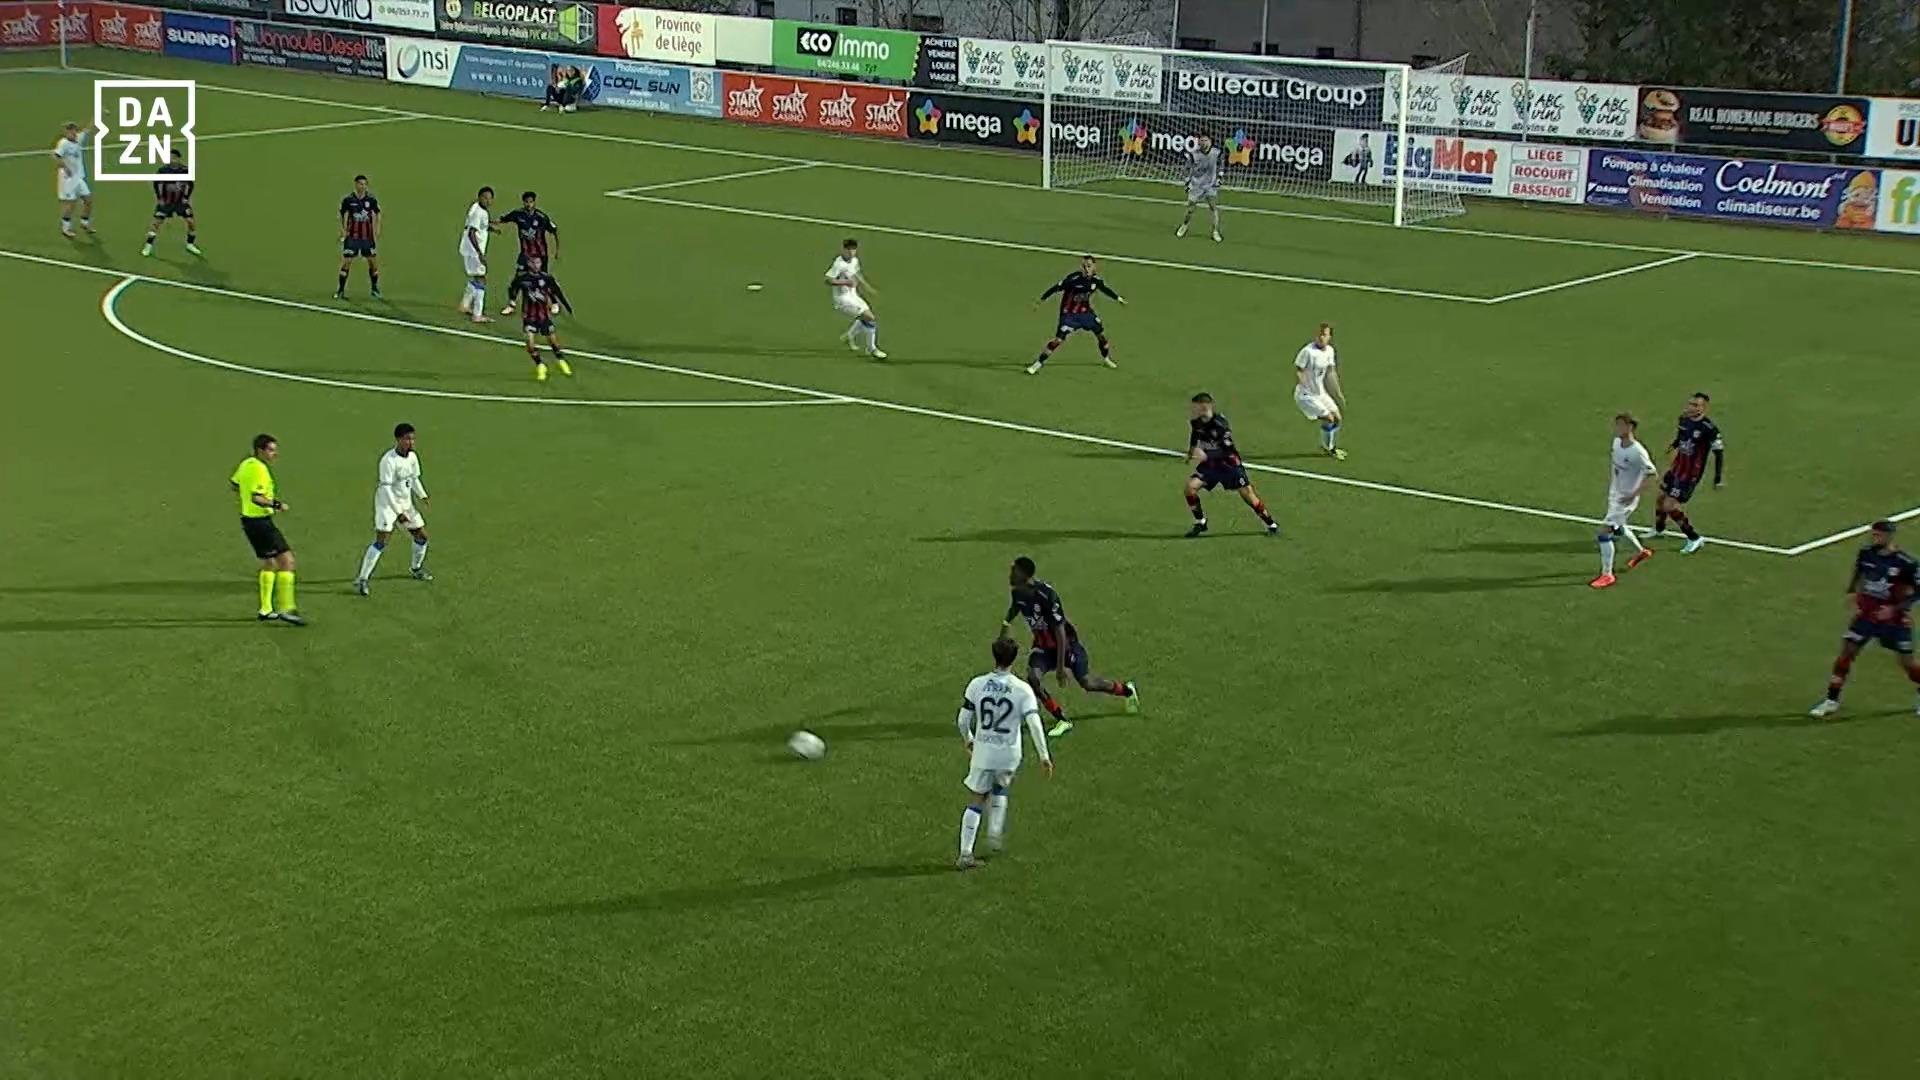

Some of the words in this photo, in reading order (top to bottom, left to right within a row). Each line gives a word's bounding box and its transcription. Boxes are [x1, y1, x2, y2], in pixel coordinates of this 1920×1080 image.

[473, 2, 556, 23] BELGOPLAST
[656, 16, 702, 33] Province
[656, 36, 670, 50] de
[672, 38, 702, 58] Liège
[839, 33, 890, 60] immo
[925, 37, 958, 48] ACHETER
[423, 47, 449, 72] nsi
[931, 61, 956, 71] LOUER
[1030, 55, 1046, 68] AB
[1028, 69, 1045, 79] vin
[603, 75, 643, 90] COOL
[647, 81, 681, 95] SUN
[1286, 78, 1367, 110] Group
[728, 84, 763, 109] STAR
[772, 88, 807, 114] STAR
[819, 92, 855, 118] STAR
[728, 106, 759, 118] CASINO
[772, 111, 804, 122] CASINO
[865, 97, 902, 123] STAR
[1689, 107, 1715, 123] REAL
[1716, 109, 1773, 126] HOMEMADE
[1773, 111, 1820, 129] BURGERS
[819, 116, 852, 128] CASINO
[865, 121, 899, 132] CASINO
[945, 111, 1001, 138] mega
[1896, 118, 1920, 146] U
[1259, 141, 1324, 171] mega
[1384, 134, 1498, 178] BigMat
[1527, 149, 1564, 162] LIEGE
[1602, 156, 1649, 173] Pompes
[1650, 161, 1658, 173] à
[1660, 162, 1706, 175] chaleur
[1514, 163, 1574, 180] ROCOURT
[1715, 160, 1833, 200] Coelmont
[1512, 183, 1573, 199] BASSENGE
[1595, 185, 1630, 195] DAIKIN
[1627, 175, 1703, 192] Climatisation
[1639, 193, 1702, 209] Ventilation
[1717, 198, 1821, 220] climatiseur.be
[980, 697, 1013, 734] 62
